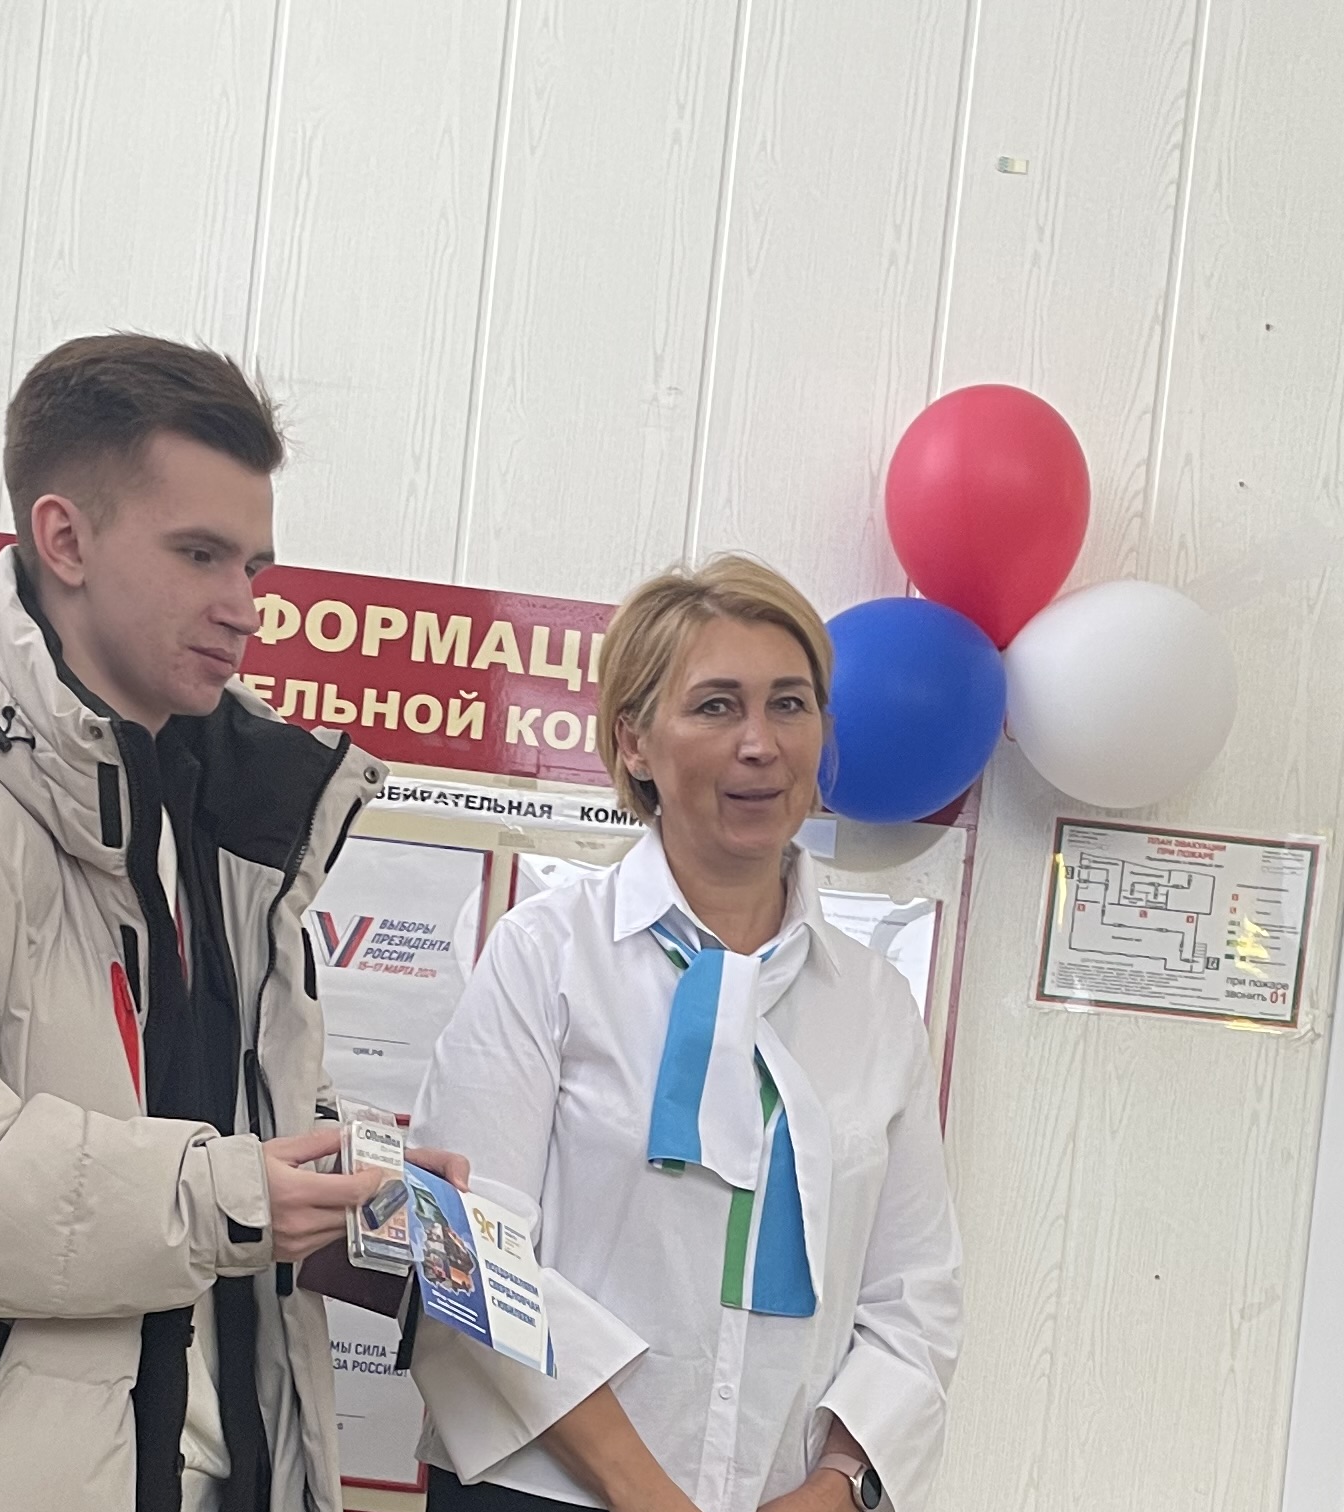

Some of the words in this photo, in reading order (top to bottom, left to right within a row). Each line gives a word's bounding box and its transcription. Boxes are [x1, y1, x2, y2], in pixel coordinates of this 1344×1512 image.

[233, 673, 486, 741] ЕЛЬНОЙ
[379, 918, 437, 935] ВЫБОРЫ
[371, 932, 452, 952] ПРЕЗИДЕНТА
[363, 947, 416, 963] РОССИИ
[382, 964, 414, 977] МАРТА
[1225, 976, 1246, 988] при
[1248, 979, 1290, 991] пожаре
[1224, 989, 1268, 1002] звонить
[1269, 990, 1287, 1004] 01
[330, 1340, 352, 1354] МЫ
[355, 1343, 387, 1358] СИЛА
[333, 1358, 349, 1371] ЗА
